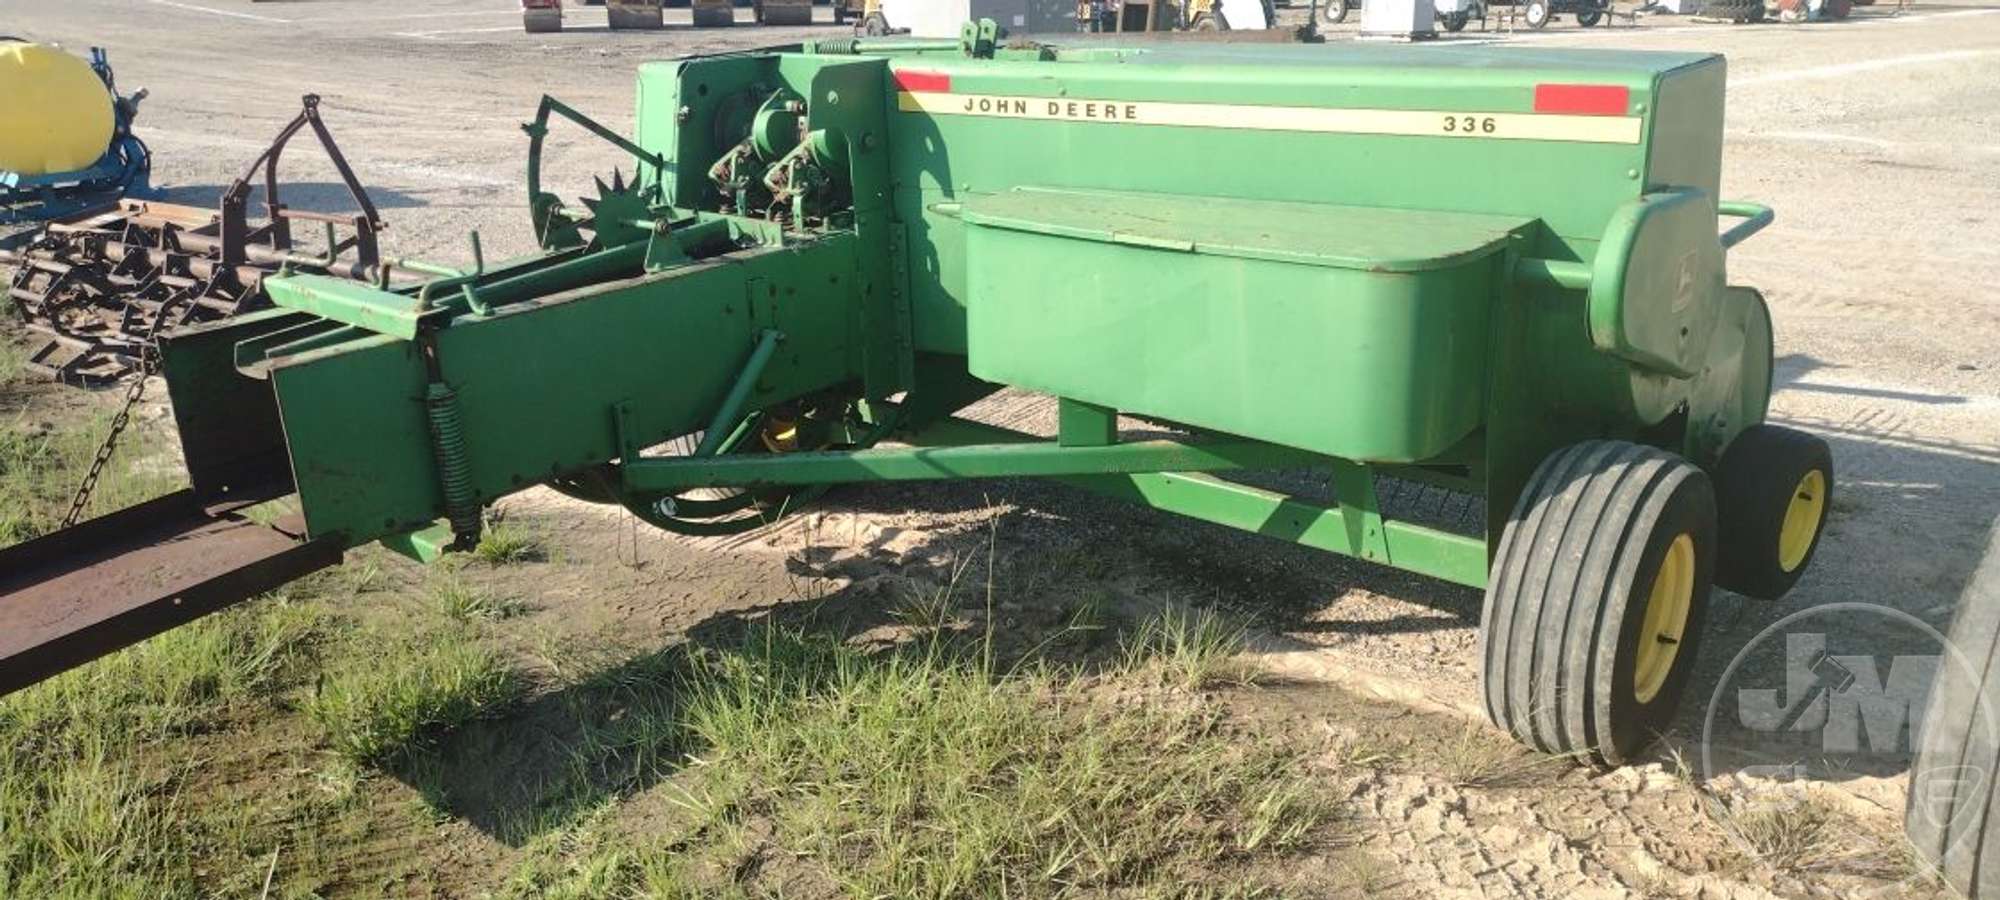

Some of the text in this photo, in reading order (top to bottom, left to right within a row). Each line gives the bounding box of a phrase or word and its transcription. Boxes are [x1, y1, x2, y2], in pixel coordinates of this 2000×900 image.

[963, 98, 1138, 120] JOHN DEERE
[1442, 116, 1497, 133] 336
